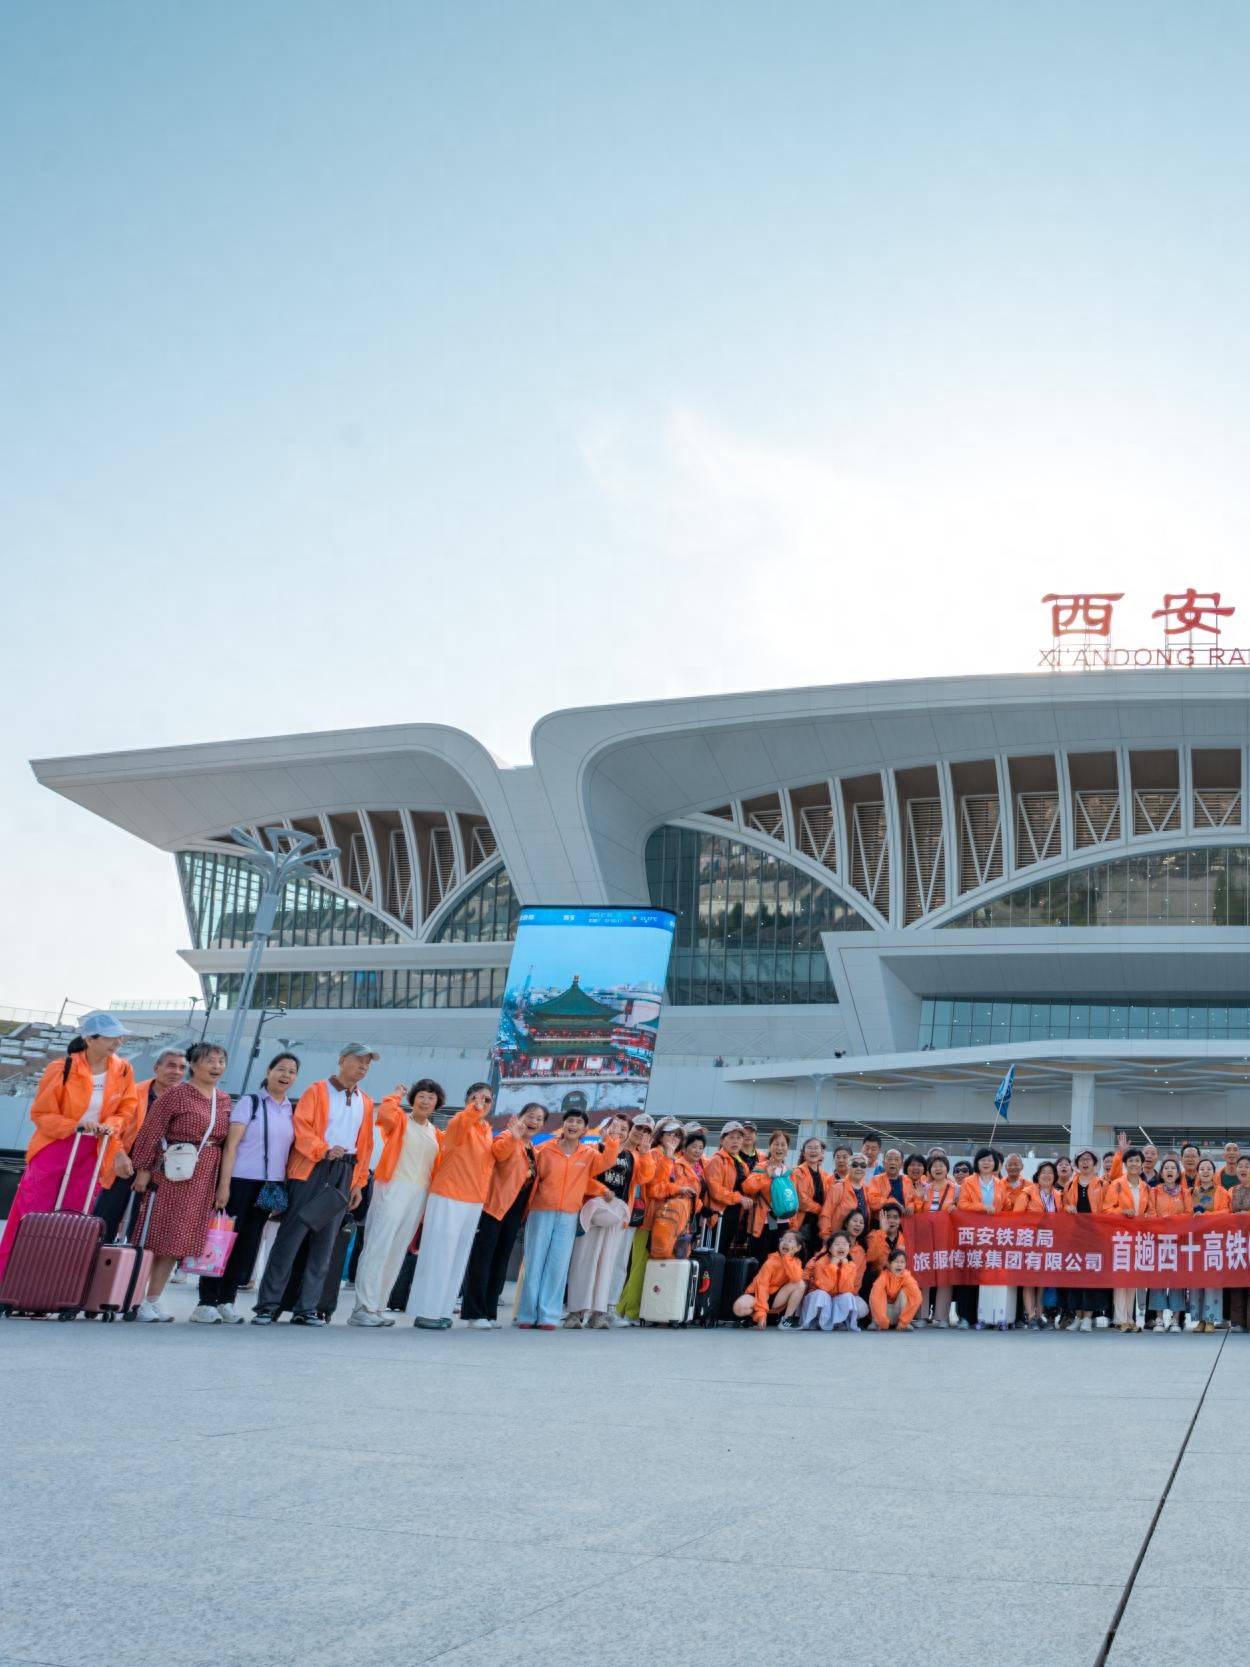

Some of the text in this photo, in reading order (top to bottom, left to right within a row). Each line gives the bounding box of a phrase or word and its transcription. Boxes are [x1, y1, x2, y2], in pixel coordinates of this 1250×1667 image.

[1038, 648, 1195, 667] XI'ANDONG
[957, 1226, 1054, 1248] 西安铁路局
[913, 1249, 1102, 1272] 旅服传媒集团有限公司
